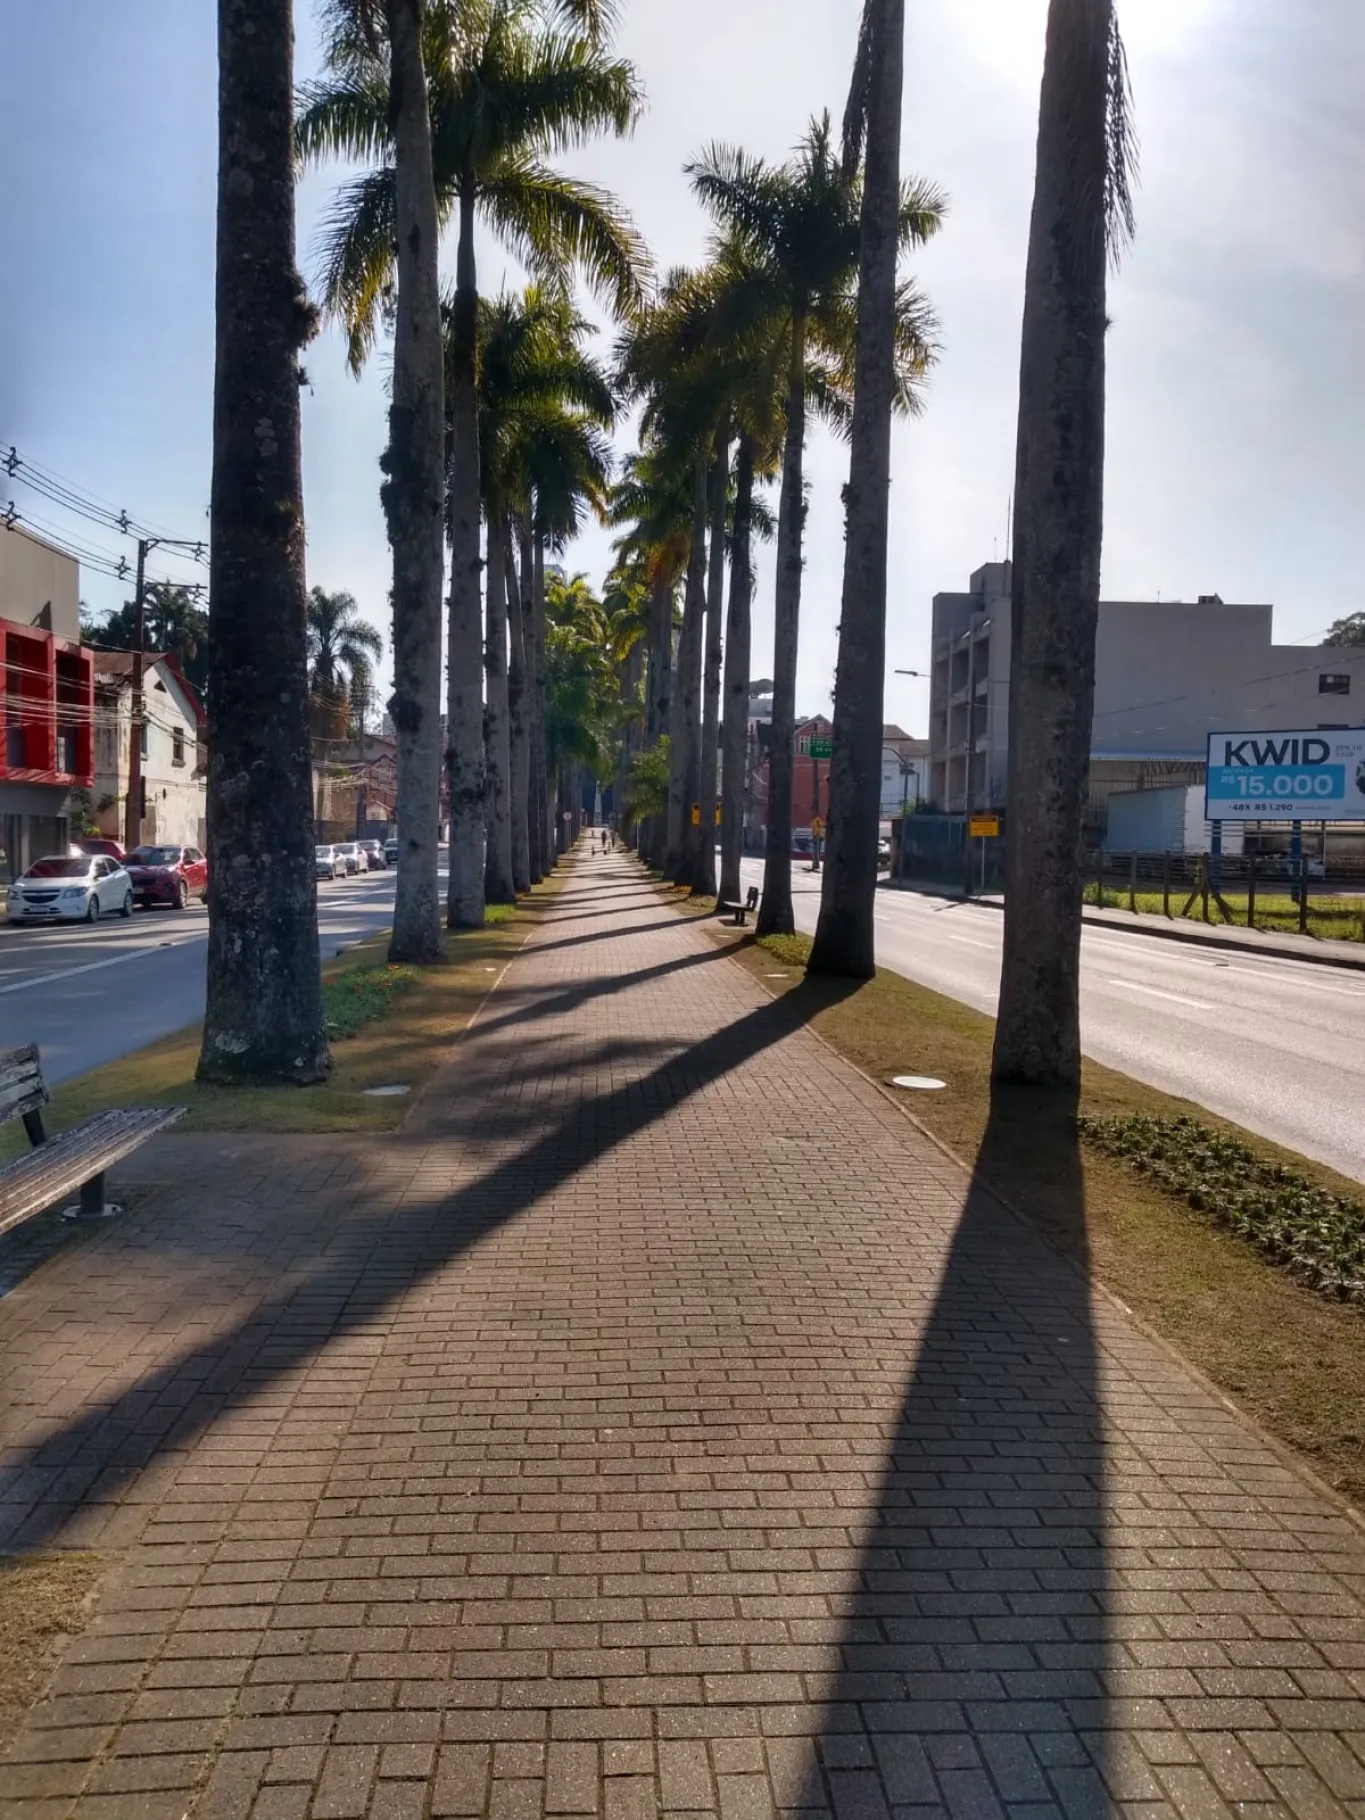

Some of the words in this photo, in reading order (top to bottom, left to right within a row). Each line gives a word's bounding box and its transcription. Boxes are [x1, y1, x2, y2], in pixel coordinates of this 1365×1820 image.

[1225, 738, 1331, 766] KWID
[1221, 775, 1236, 785] R$
[1237, 774, 1333, 796] 15.000
[1254, 802, 1267, 811] R$
[1269, 803, 1293, 811] 1.290
